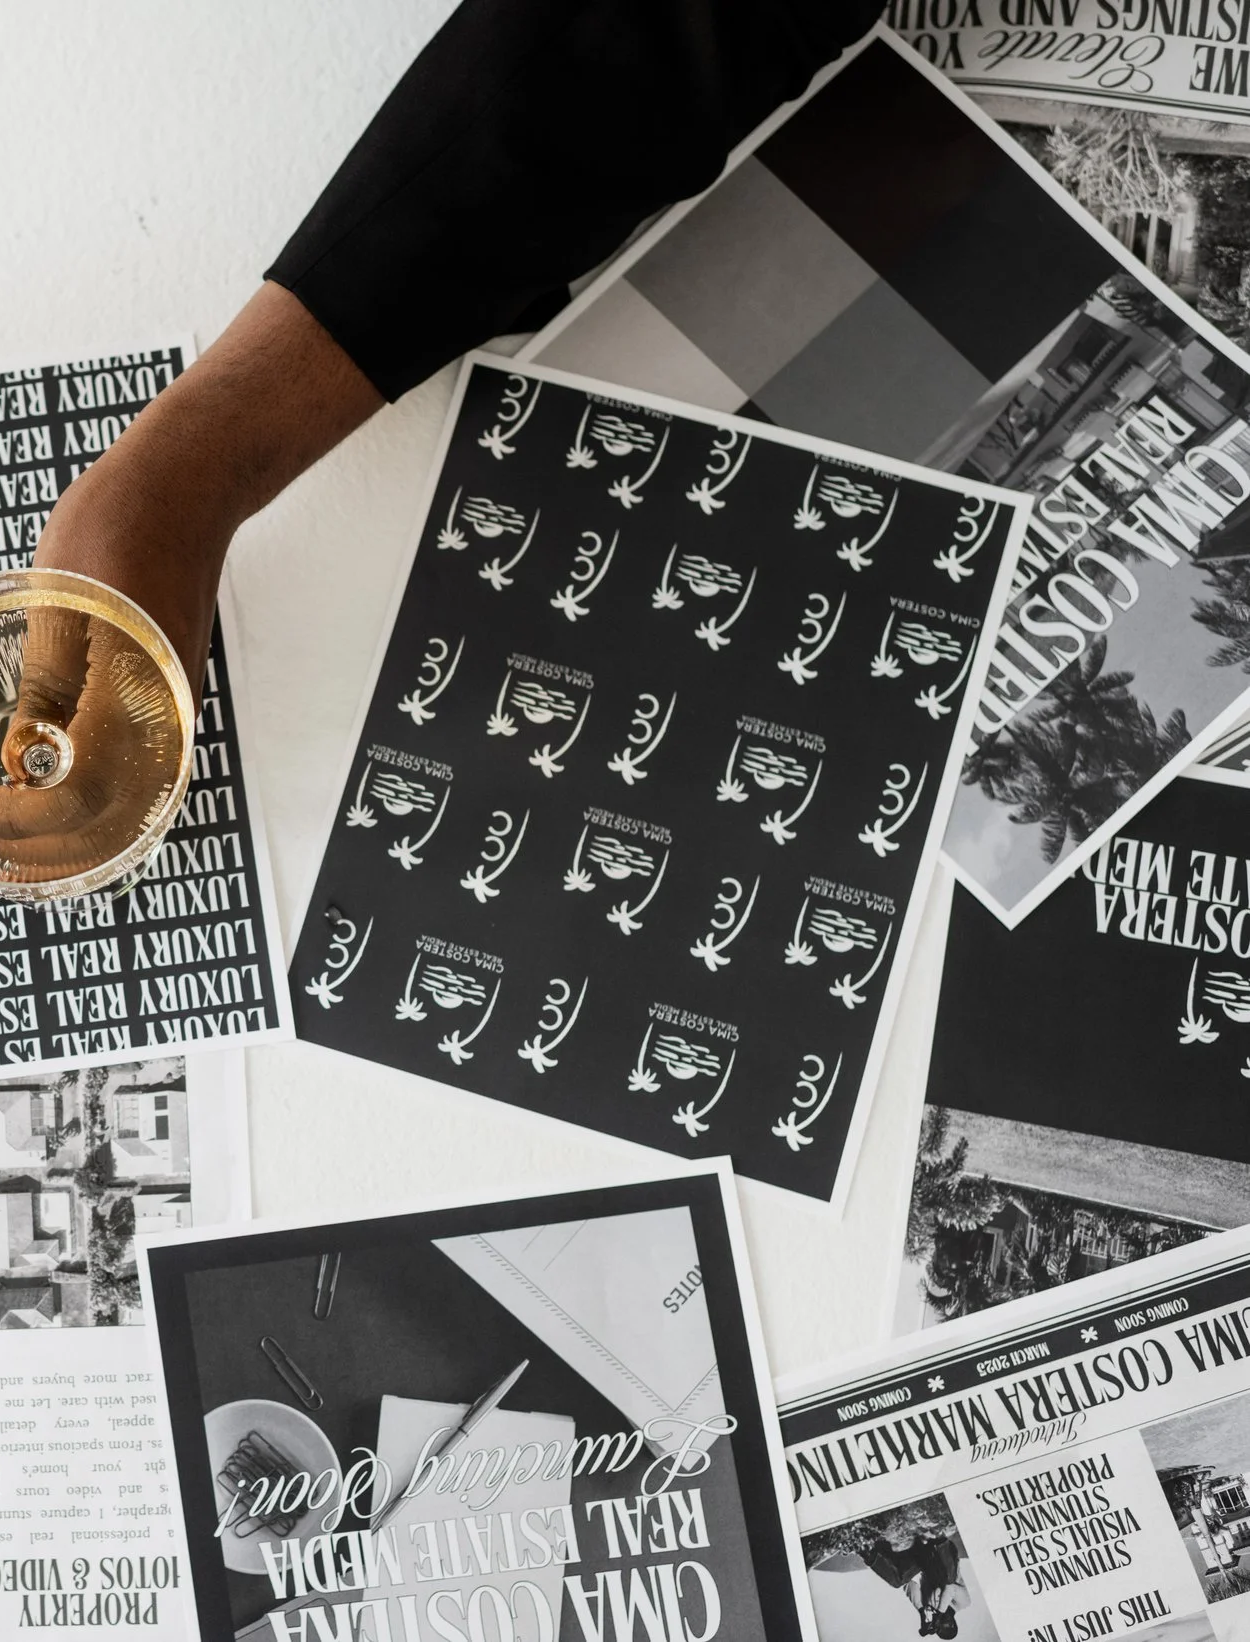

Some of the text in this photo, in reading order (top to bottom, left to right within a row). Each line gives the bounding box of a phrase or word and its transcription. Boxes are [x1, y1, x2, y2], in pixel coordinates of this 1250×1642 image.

[998, 0, 1080, 28] AND
[977, 30, 1250, 97] WE Elevate
[56, 362, 174, 416] LUXURY
[1080, 395, 1196, 494] REAL
[972, 445, 1250, 734] CIMA COSTE
[506, 656, 594, 689] CIMA COSTERA
[127, 872, 249, 924] LUXURY
[41, 934, 121, 982] REAL
[133, 918, 257, 969] LUXURY
[415, 939, 504, 973] CIMA COSTERA
[47, 981, 127, 1029] REAL
[139, 963, 263, 1016] LUXURY
[52, 1022, 131, 1056] REAL
[144, 1006, 267, 1048] LUXURY
[648, 1007, 739, 1042] CIMA COSTERA
[653, 1002, 738, 1033] REAL ESTATE MEDIA
[836, 1296, 1189, 1422] COMING SOON MARCH 2025 COMING SOON
[995, 1346, 1173, 1429] COSTERA
[969, 1410, 1086, 1465] Introducing
[214, 1414, 738, 1538] Launching Soon!
[975, 1453, 1115, 1517] PROPERTIES.
[28, 1530, 55, 1546] real
[70, 1525, 152, 1545] professional
[1003, 1485, 1110, 1541] STUNNING
[258, 1488, 711, 1600] REAL ESTATE MEDIA
[993, 1506, 1141, 1573] VISUALS SELL
[72, 1557, 89, 1590] &
[1024, 1539, 1132, 1595] STUNNING
[18, 1592, 158, 1628] PROPERTY
[563, 1561, 722, 1642] CIMA
[1058, 1606, 1113, 1641] JUST
[1118, 1589, 1170, 1625] THIS
